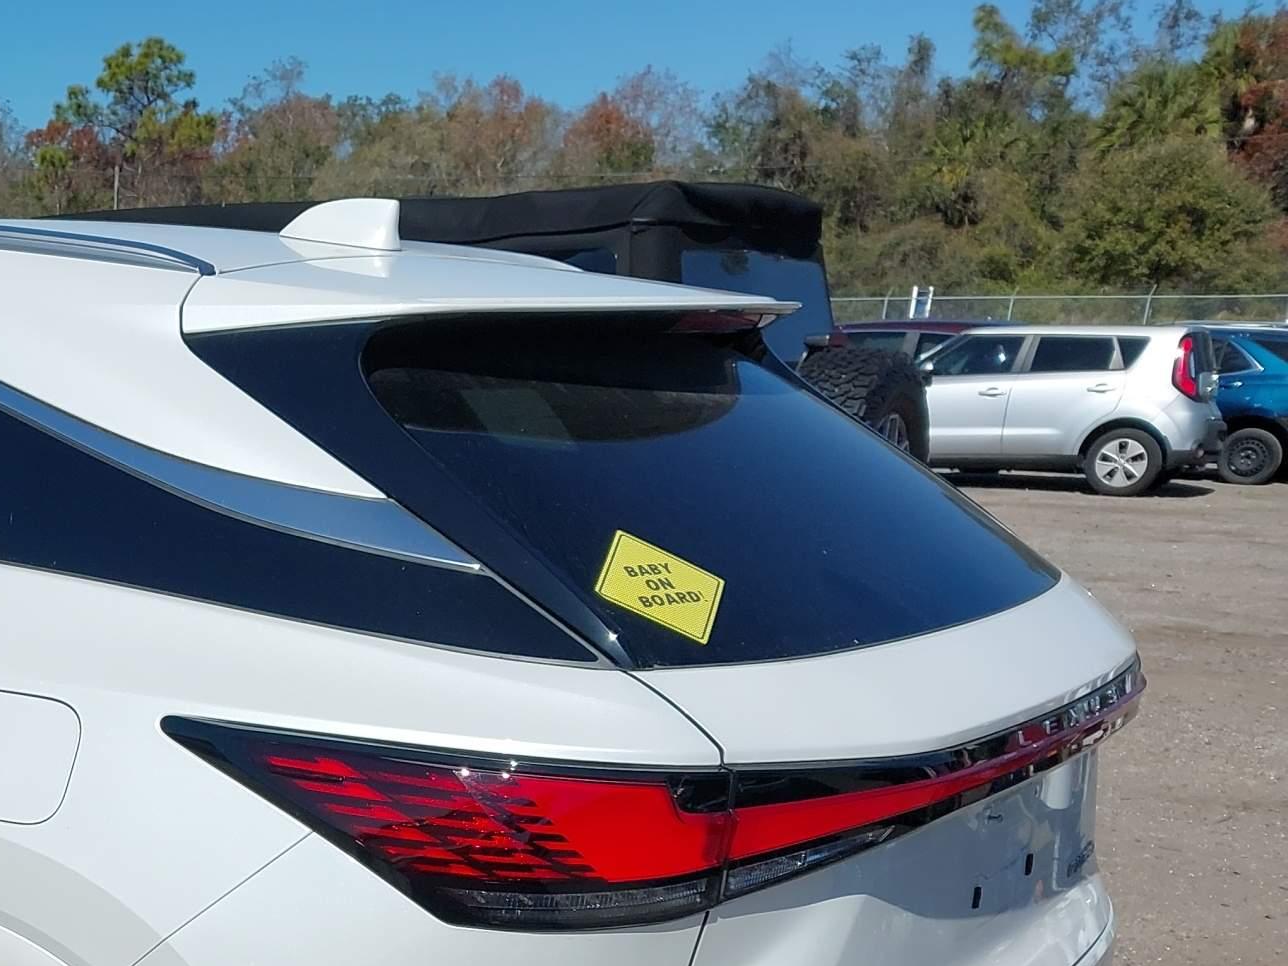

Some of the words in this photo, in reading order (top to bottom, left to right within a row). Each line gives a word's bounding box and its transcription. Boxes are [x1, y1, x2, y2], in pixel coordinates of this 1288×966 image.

[623, 563, 672, 577] BABY
[645, 577, 676, 591] ON
[638, 591, 709, 608] BOARD!
[1017, 686, 1119, 747] LEXUS
